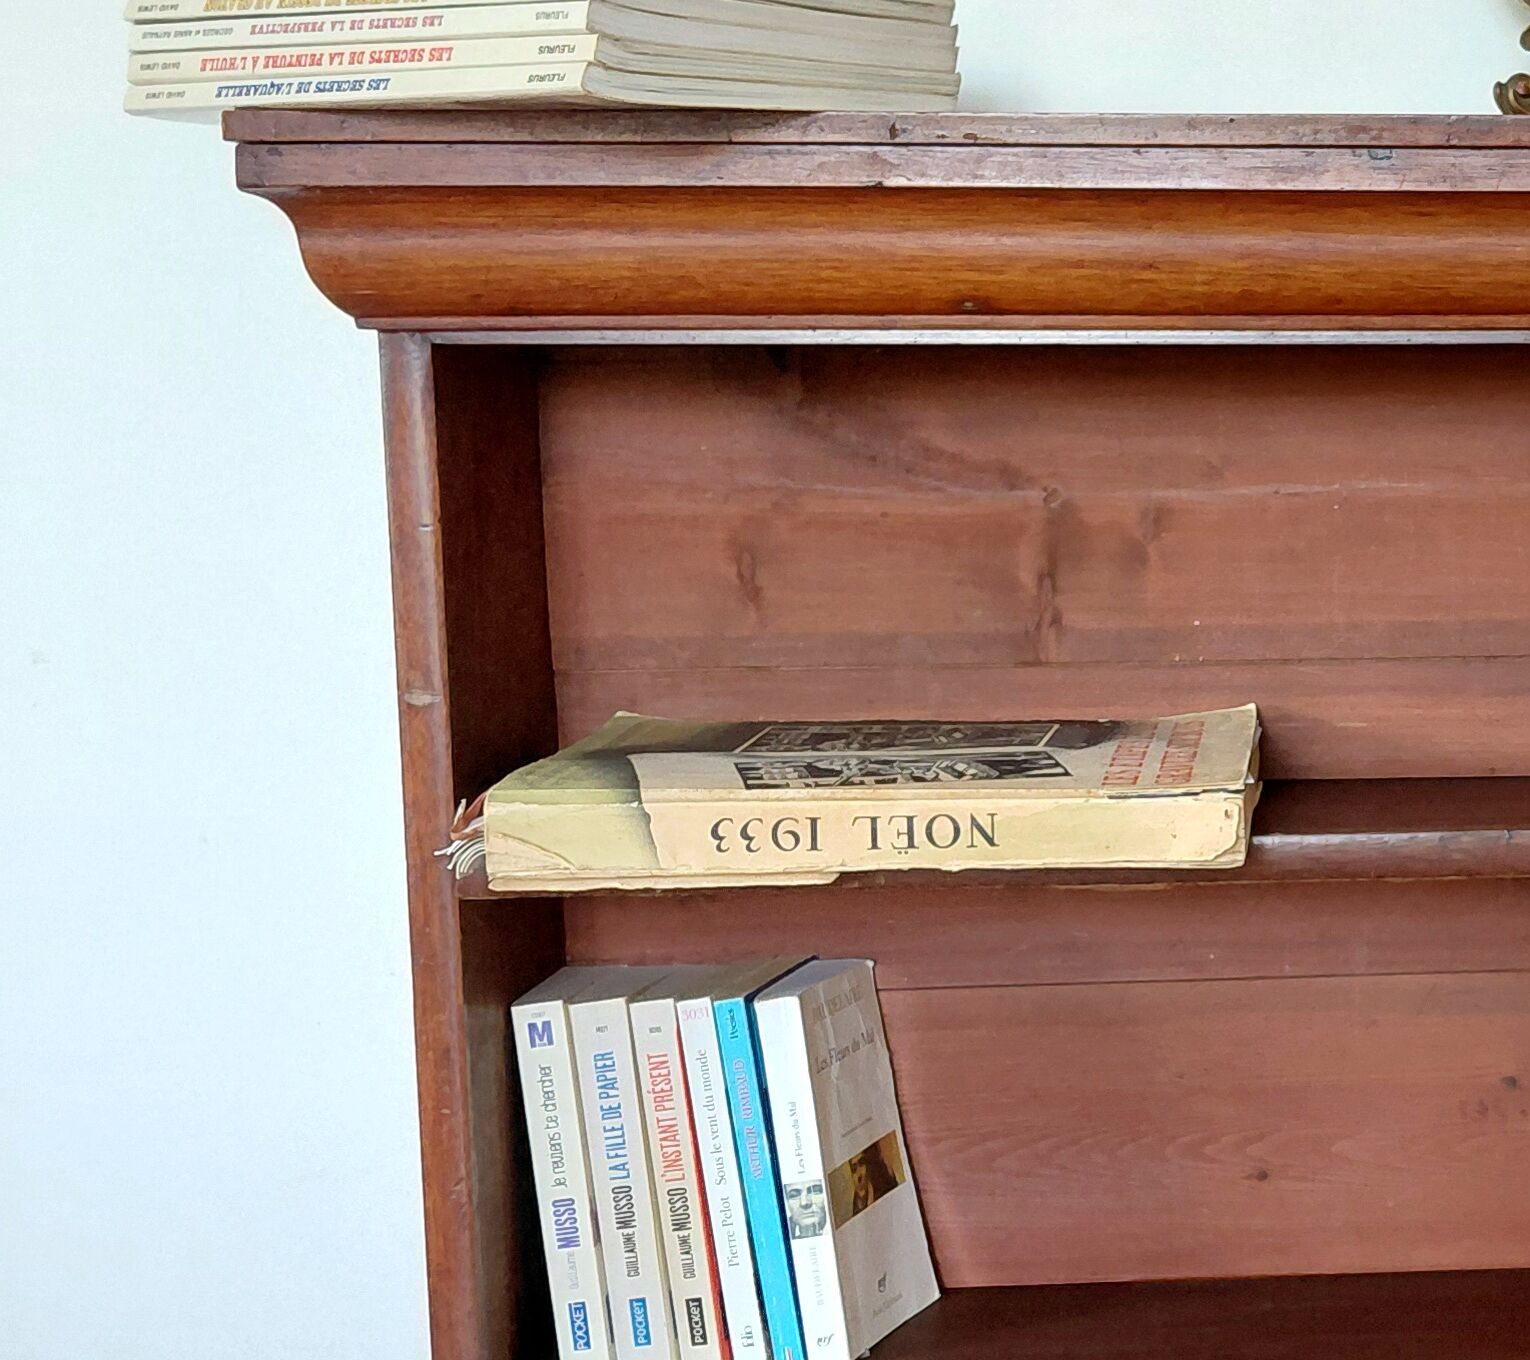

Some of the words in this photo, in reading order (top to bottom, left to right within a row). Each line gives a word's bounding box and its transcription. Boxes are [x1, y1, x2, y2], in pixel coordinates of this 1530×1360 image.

[349, 19, 365, 31] DE
[368, 17, 418, 30] SECRETS
[421, 15, 444, 28] LES
[536, 11, 569, 21] FLEURUS
[250, 21, 326, 36] PERSPECTIVE
[330, 21, 346, 32] LA
[348, 51, 365, 66] DE
[368, 48, 426, 64] SECRETS
[428, 47, 454, 62] LES
[538, 44, 576, 55] FLEURUS
[200, 57, 248, 72] L'HUILE
[251, 56, 260, 74] À
[263, 53, 324, 69] PEINTURE
[328, 52, 345, 66] LA
[313, 80, 366, 93] SECRETS
[366, 78, 391, 91] LES
[527, 73, 566, 83] FLEURUS
[215, 80, 294, 98] L'AQUARELLE
[295, 81, 313, 94] DE
[710, 816, 823, 854] 1933
[852, 812, 1001, 855] NOËL
[681, 1007, 710, 1022] 3031
[593, 1050, 620, 1100] PAPIER
[696, 1049, 713, 1091] monde
[537, 1064, 558, 1113] chercher
[646, 1053, 676, 1113] PRÉSENT
[733, 1058, 752, 1121] RIMBAUD
[600, 1102, 623, 1121] DE
[703, 1093, 716, 1112] du
[787, 1101, 798, 1117] Mal
[543, 1115, 560, 1130] te
[707, 1114, 721, 1143] vent
[791, 1119, 800, 1130] du
[603, 1123, 628, 1160] FILLE
[655, 1117, 686, 1183] L'INSTANT
[710, 1143, 723, 1155] le
[795, 1131, 804, 1157] Fleurs
[548, 1132, 566, 1174] reviens
[744, 1125, 763, 1180] ARTHUR
[609, 1162, 631, 1181] LA
[714, 1157, 728, 1187] Sous
[797, 1159, 806, 1174] Les
[550, 1176, 568, 1188] Je
[611, 1185, 637, 1231] MUSSO
[667, 1187, 693, 1233] MUSSO
[720, 1195, 734, 1228] Pelot
[552, 1197, 582, 1250] MUSSO
[621, 1230, 641, 1278] GUILLAUME
[677, 1232, 696, 1280] GUILLAUME
[727, 1230, 740, 1268] Pierre
[569, 1302, 590, 1350] POCKET
